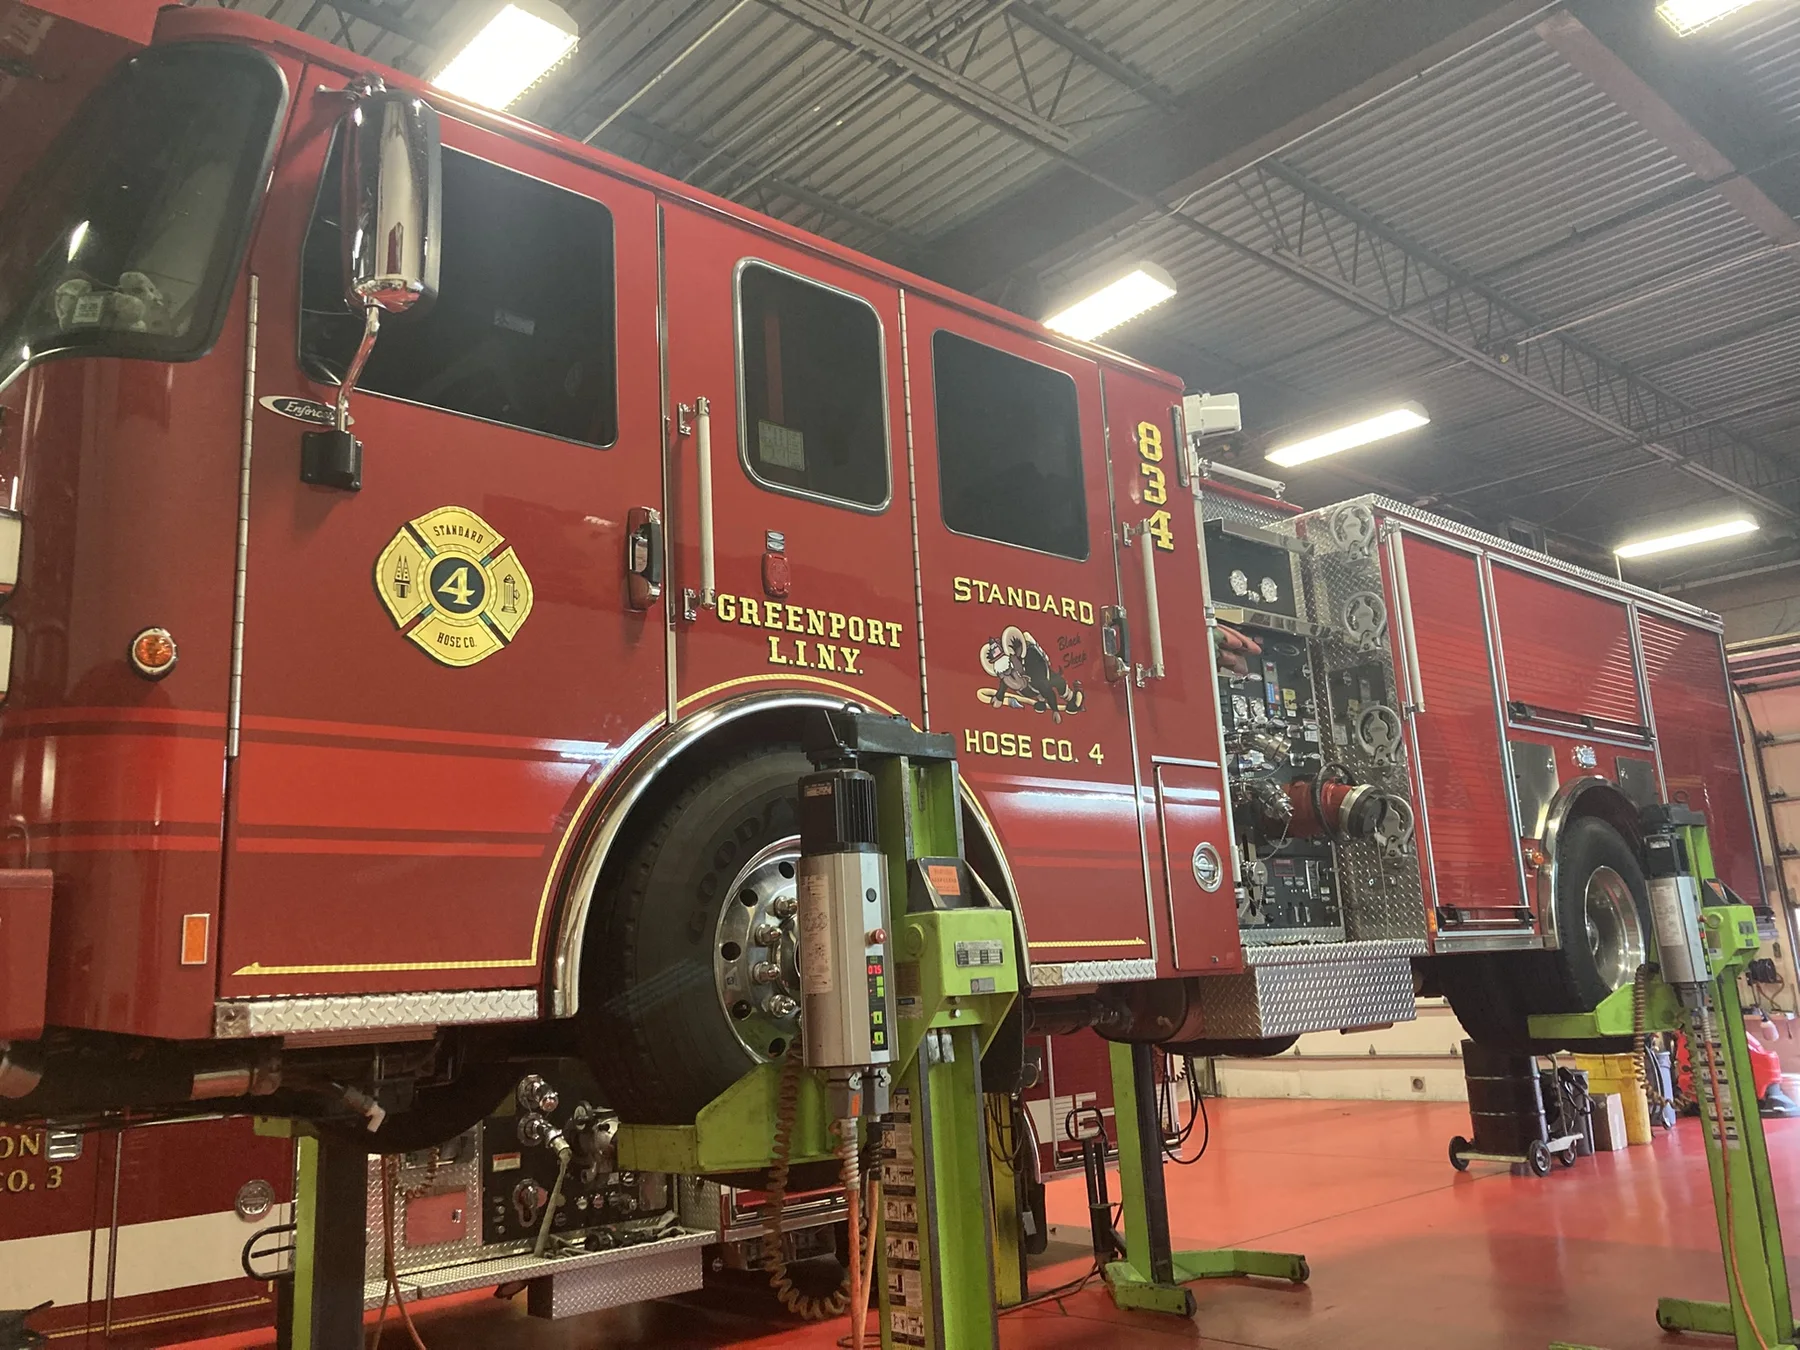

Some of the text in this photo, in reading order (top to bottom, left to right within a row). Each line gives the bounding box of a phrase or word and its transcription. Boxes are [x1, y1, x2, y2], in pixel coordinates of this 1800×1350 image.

[1137, 420, 1175, 551] 834
[433, 524, 484, 545] STANDARD
[437, 566, 476, 606] 4
[953, 575, 1095, 626] STANDARD
[436, 632, 478, 649] HOSE CO.
[716, 593, 903, 649] GREENPORT
[767, 635, 865, 676] L.I.N.Y.
[1057, 632, 1081, 651] Black
[963, 728, 1105, 766] HOSE CO. 4
[46, 1165, 63, 1189] 3
